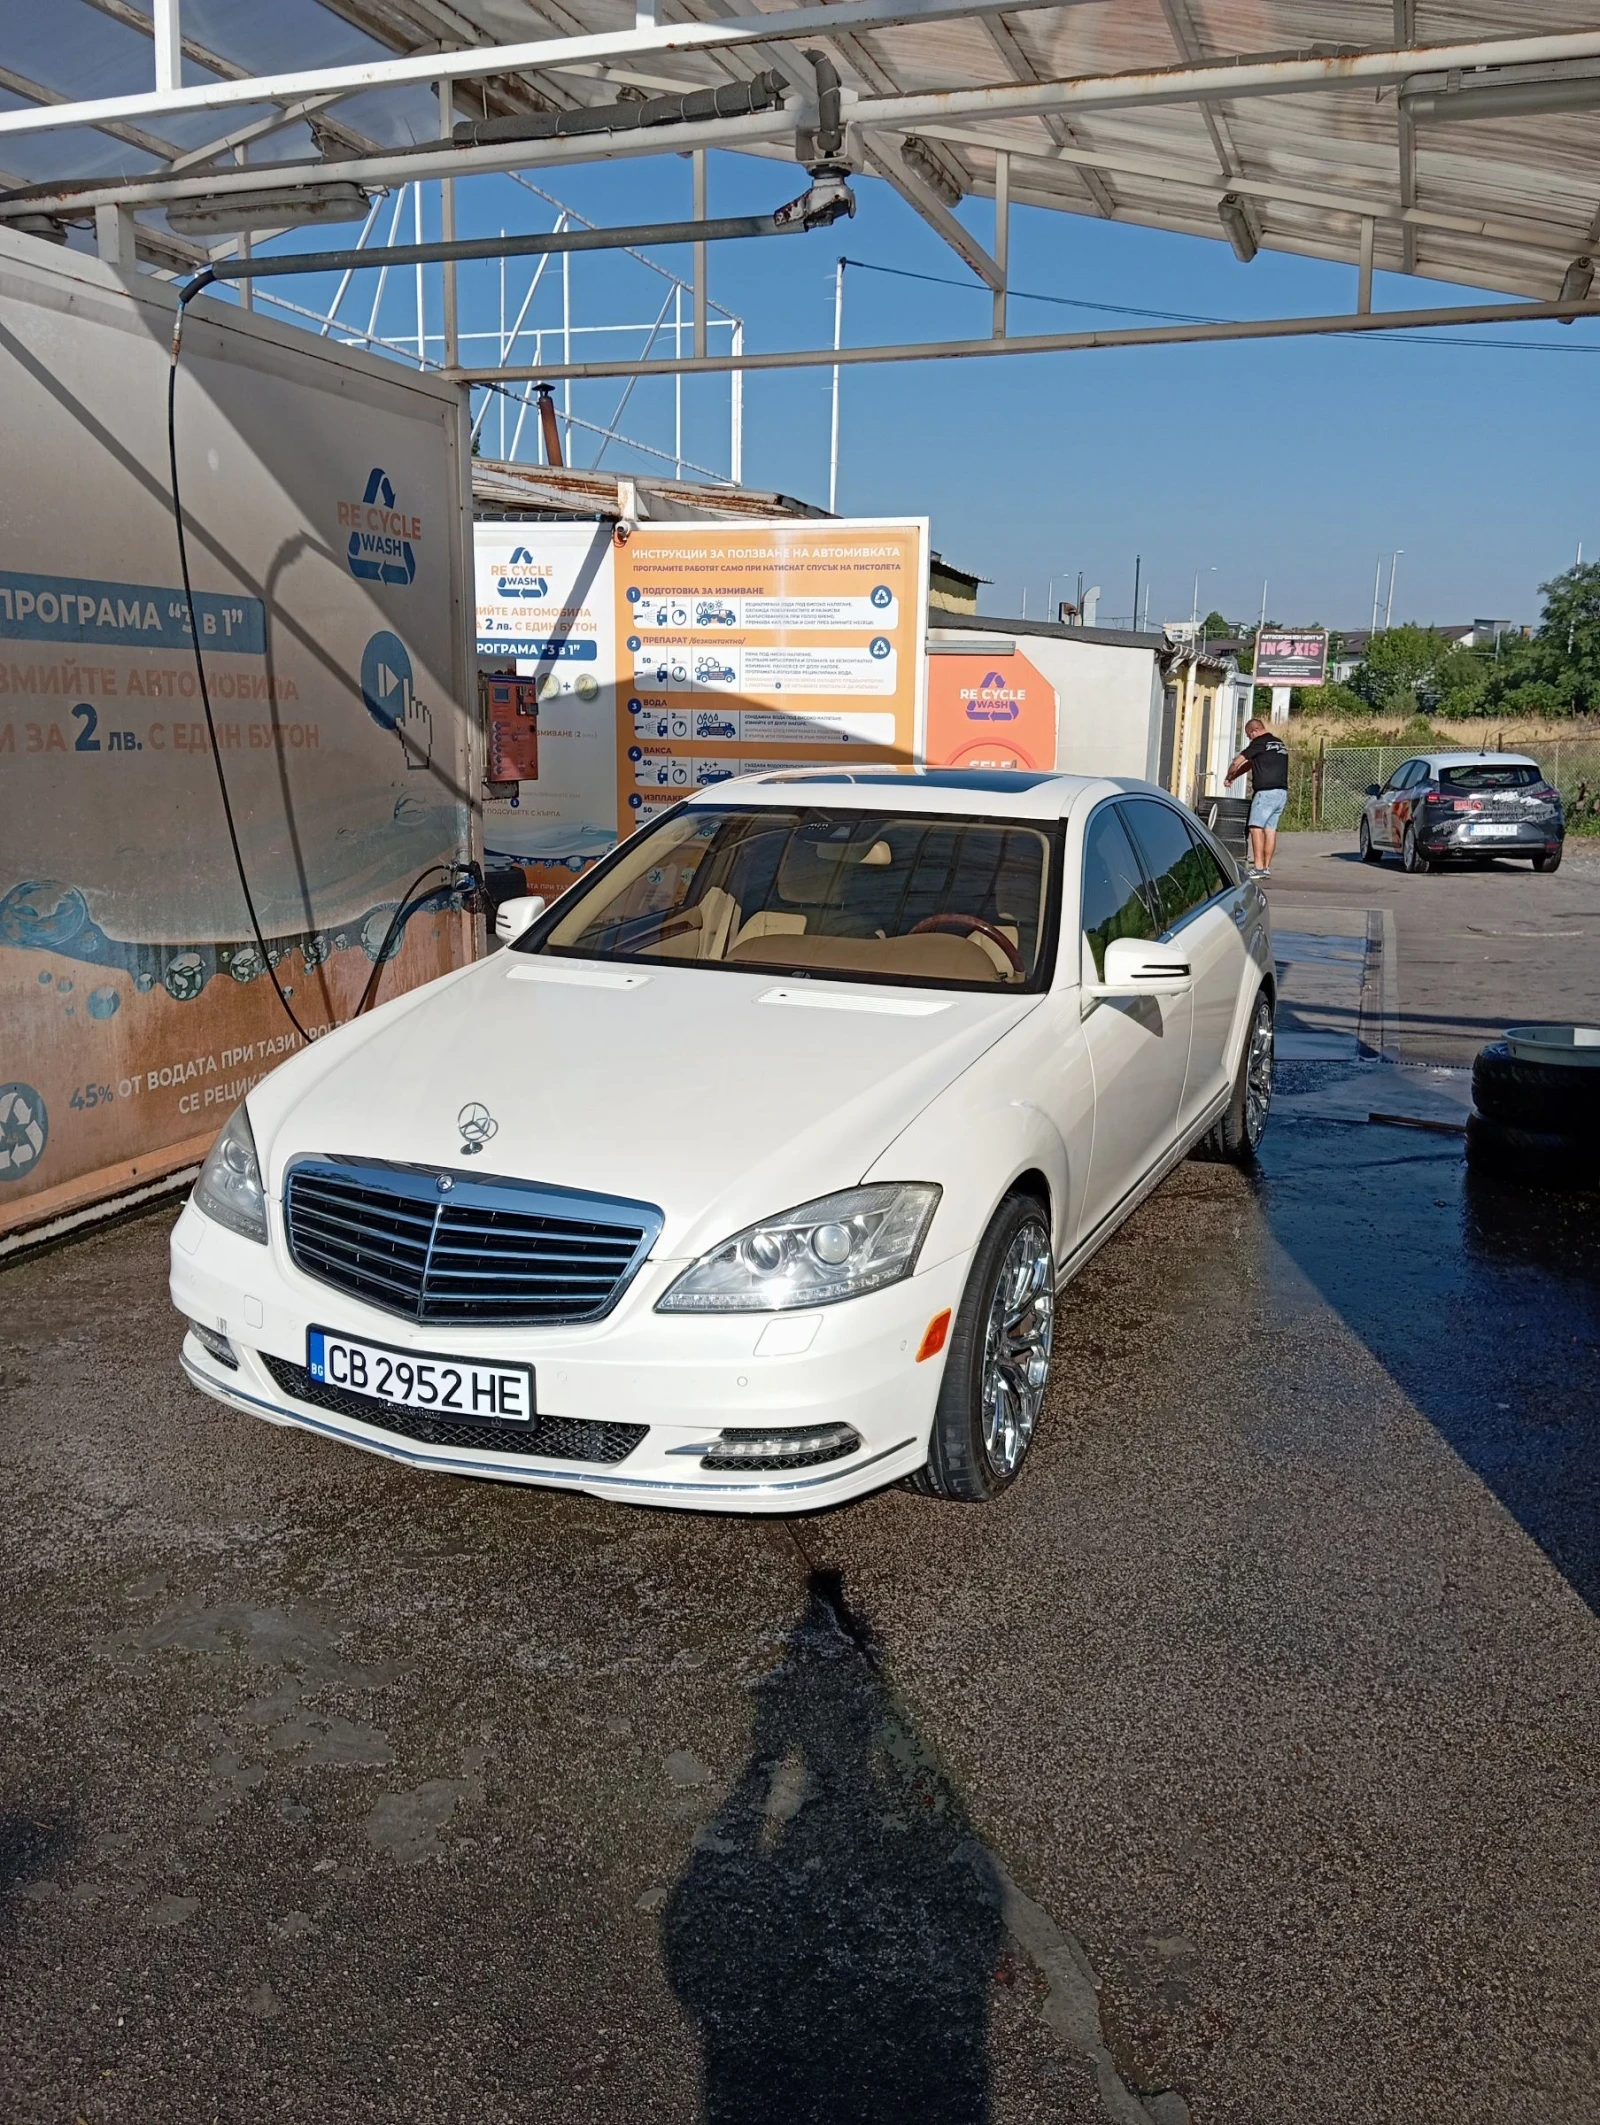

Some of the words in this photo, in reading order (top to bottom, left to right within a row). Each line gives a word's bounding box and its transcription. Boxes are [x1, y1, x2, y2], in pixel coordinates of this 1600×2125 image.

[337, 502, 361, 528] RE
[366, 506, 421, 540] CYCLE
[361, 533, 402, 557] WASH
[632, 549, 707, 558] ИНСТРУКЦИИ
[710, 549, 724, 558] ЗА
[728, 549, 789, 558] ПОЛЗВАНЕ
[793, 549, 808, 558] НА
[812, 549, 900, 558] АВТОМИВКАТА
[491, 566, 507, 576] RE
[512, 566, 553, 576] CYCLE
[507, 578, 538, 586] WASH
[511, 608, 592, 617] АВТОМОБИЛА
[485, 618, 494, 630] 2
[515, 622, 522, 630] С
[525, 622, 558, 632] ЕДИН
[560, 622, 598, 632] БУТОН
[126, 668, 298, 701] АВТОМОБИЛА
[960, 689, 978, 700] RE
[982, 689, 1026, 700] CYCLE
[24, 724, 67, 753] ЗА
[72, 703, 100, 752] 2
[107, 731, 143, 752] лв.
[149, 724, 166, 751] С
[173, 723, 242, 752] ЕДИН
[248, 722, 320, 750] БУТОН
[69, 1082, 114, 1112] 45%
[118, 1074, 143, 1099] ОТ
[147, 1056, 217, 1092] ВОДАТА
[221, 1043, 254, 1070] ПРИ
[257, 1032, 296, 1060] ТАЗИ
[179, 1092, 200, 1115] СЕ
[311, 1363, 324, 1376] BG
[328, 1344, 369, 1389] CB
[375, 1357, 463, 1408] 2952
[472, 1372, 523, 1417] HE
